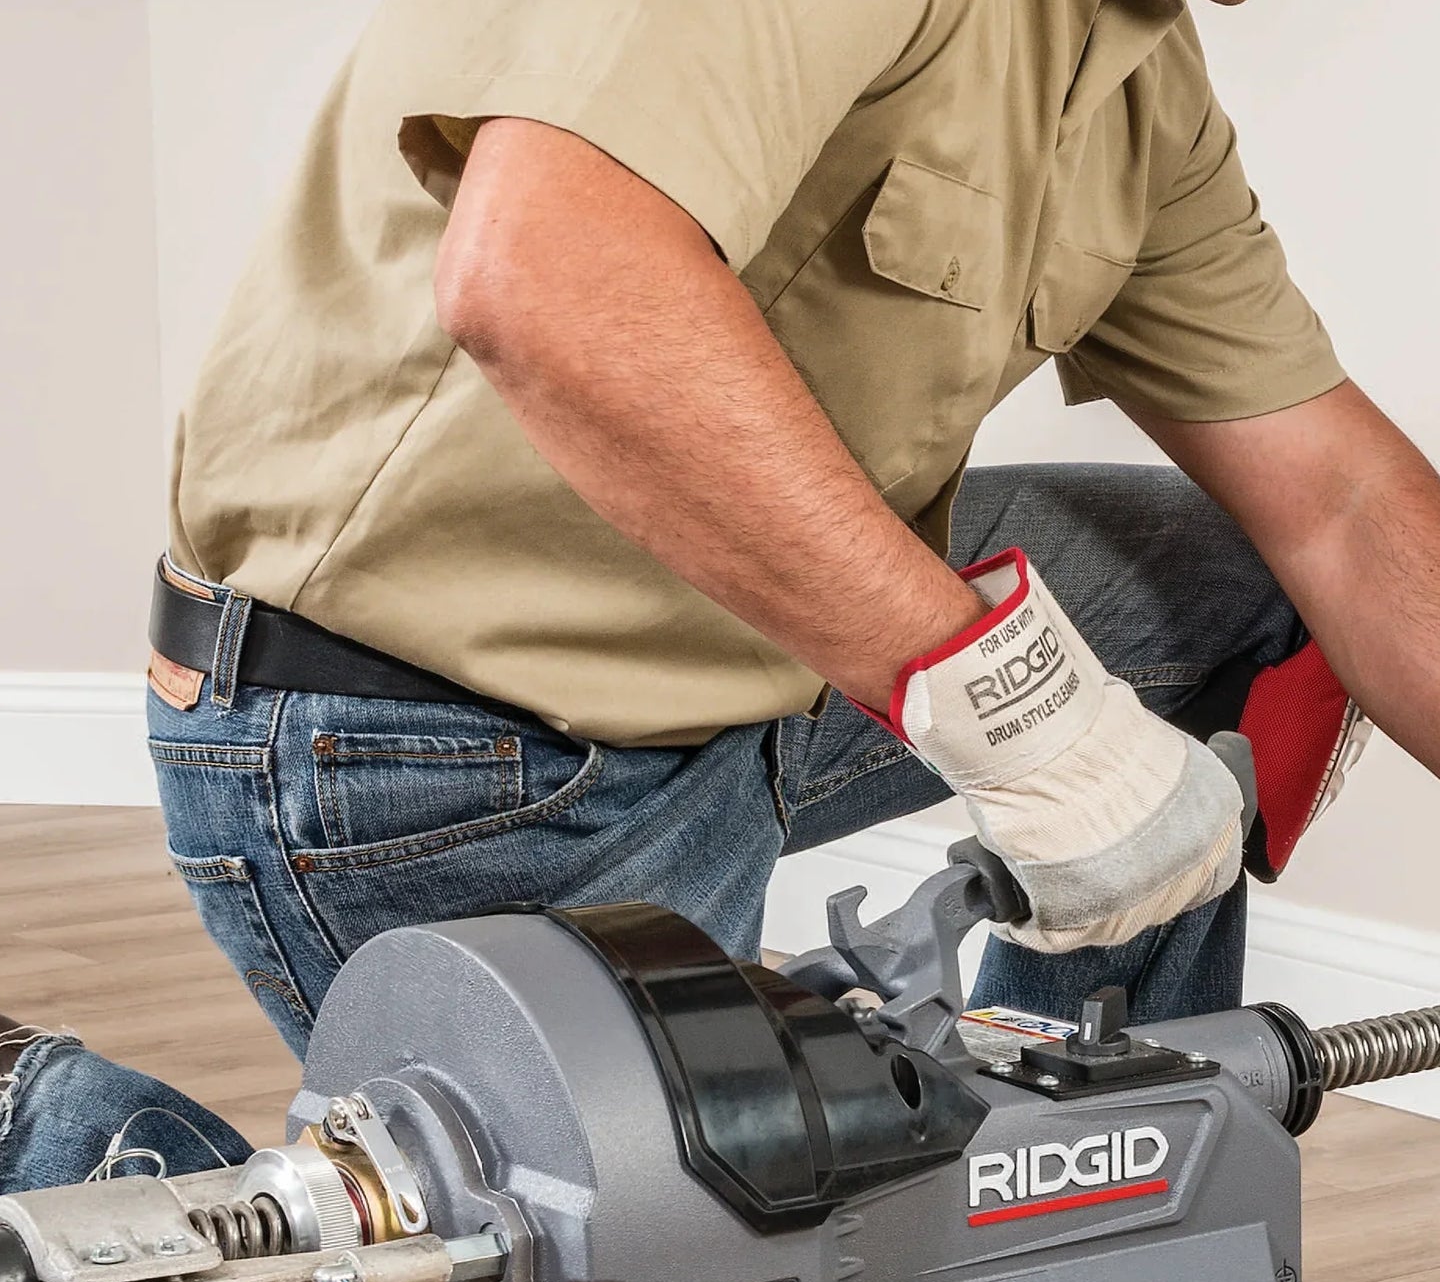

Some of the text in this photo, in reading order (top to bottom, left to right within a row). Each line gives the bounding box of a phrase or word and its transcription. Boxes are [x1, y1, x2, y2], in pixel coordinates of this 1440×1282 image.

[964, 626, 1061, 710] RIDGID
[978, 634, 1003, 658] FOR
[1000, 620, 1021, 643] USE
[986, 718, 1023, 746] DRUM
[1022, 699, 1055, 729] STYLE
[967, 1126, 1170, 1208] RIDGID
